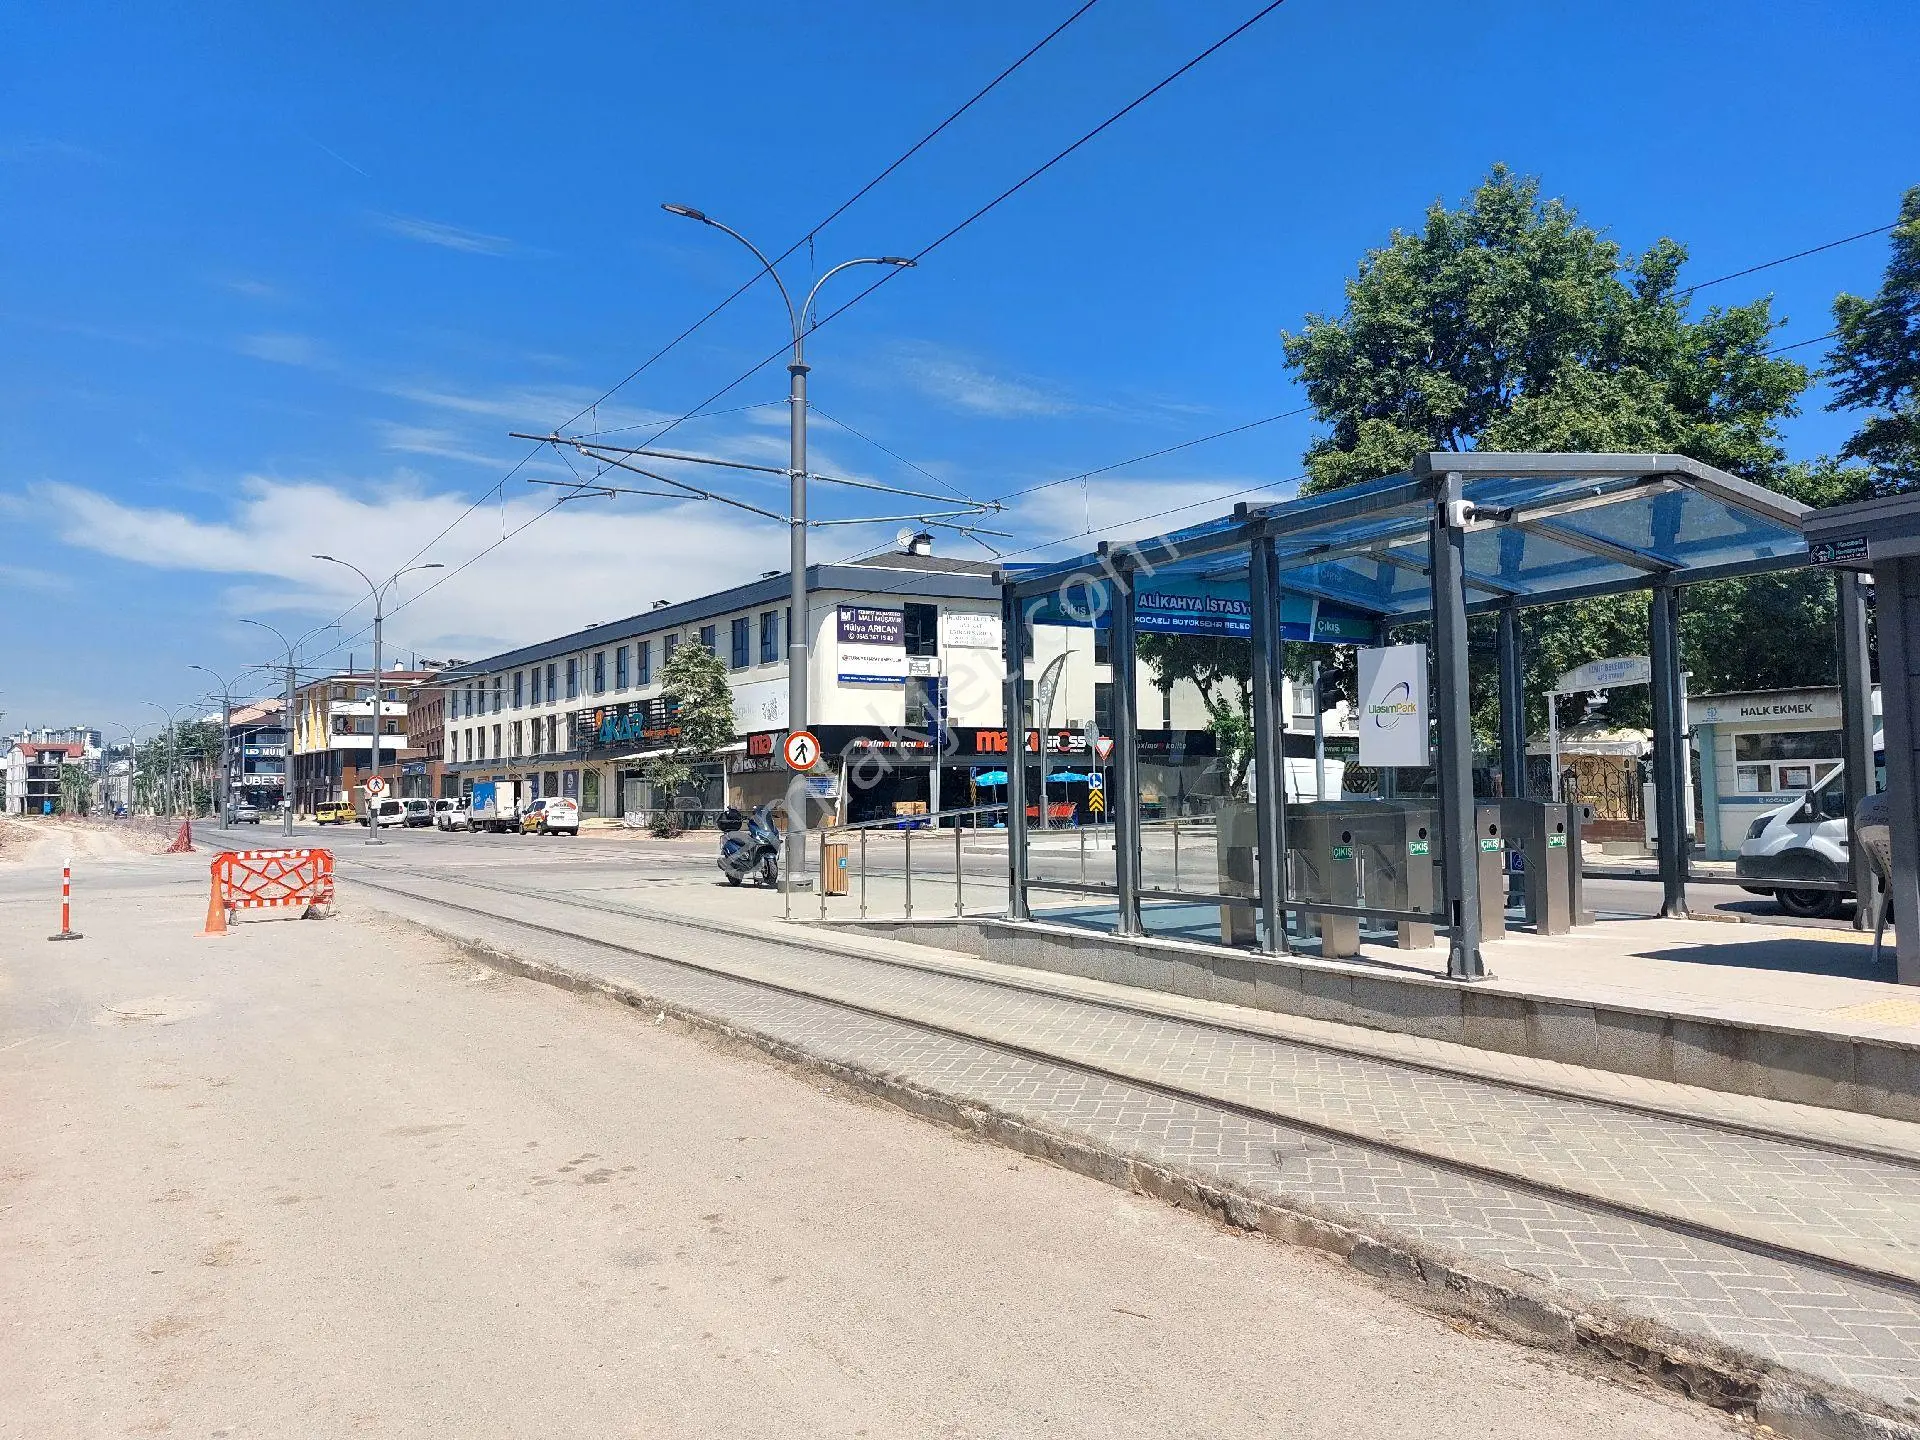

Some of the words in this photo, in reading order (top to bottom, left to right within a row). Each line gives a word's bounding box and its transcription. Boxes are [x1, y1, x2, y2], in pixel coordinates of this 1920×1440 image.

[1139, 594, 1203, 611] ALİKAHYA
[843, 623, 866, 632] Hülya
[1317, 620, 1341, 634] Çıkış
[1740, 706, 1771, 716] HALK
[1772, 703, 1814, 714] EKMEK
[1410, 842, 1428, 854] ÇIKIŞ
[1482, 839, 1499, 851] ÇIKIŞ
[1333, 847, 1353, 859] ÇIKIŞ
